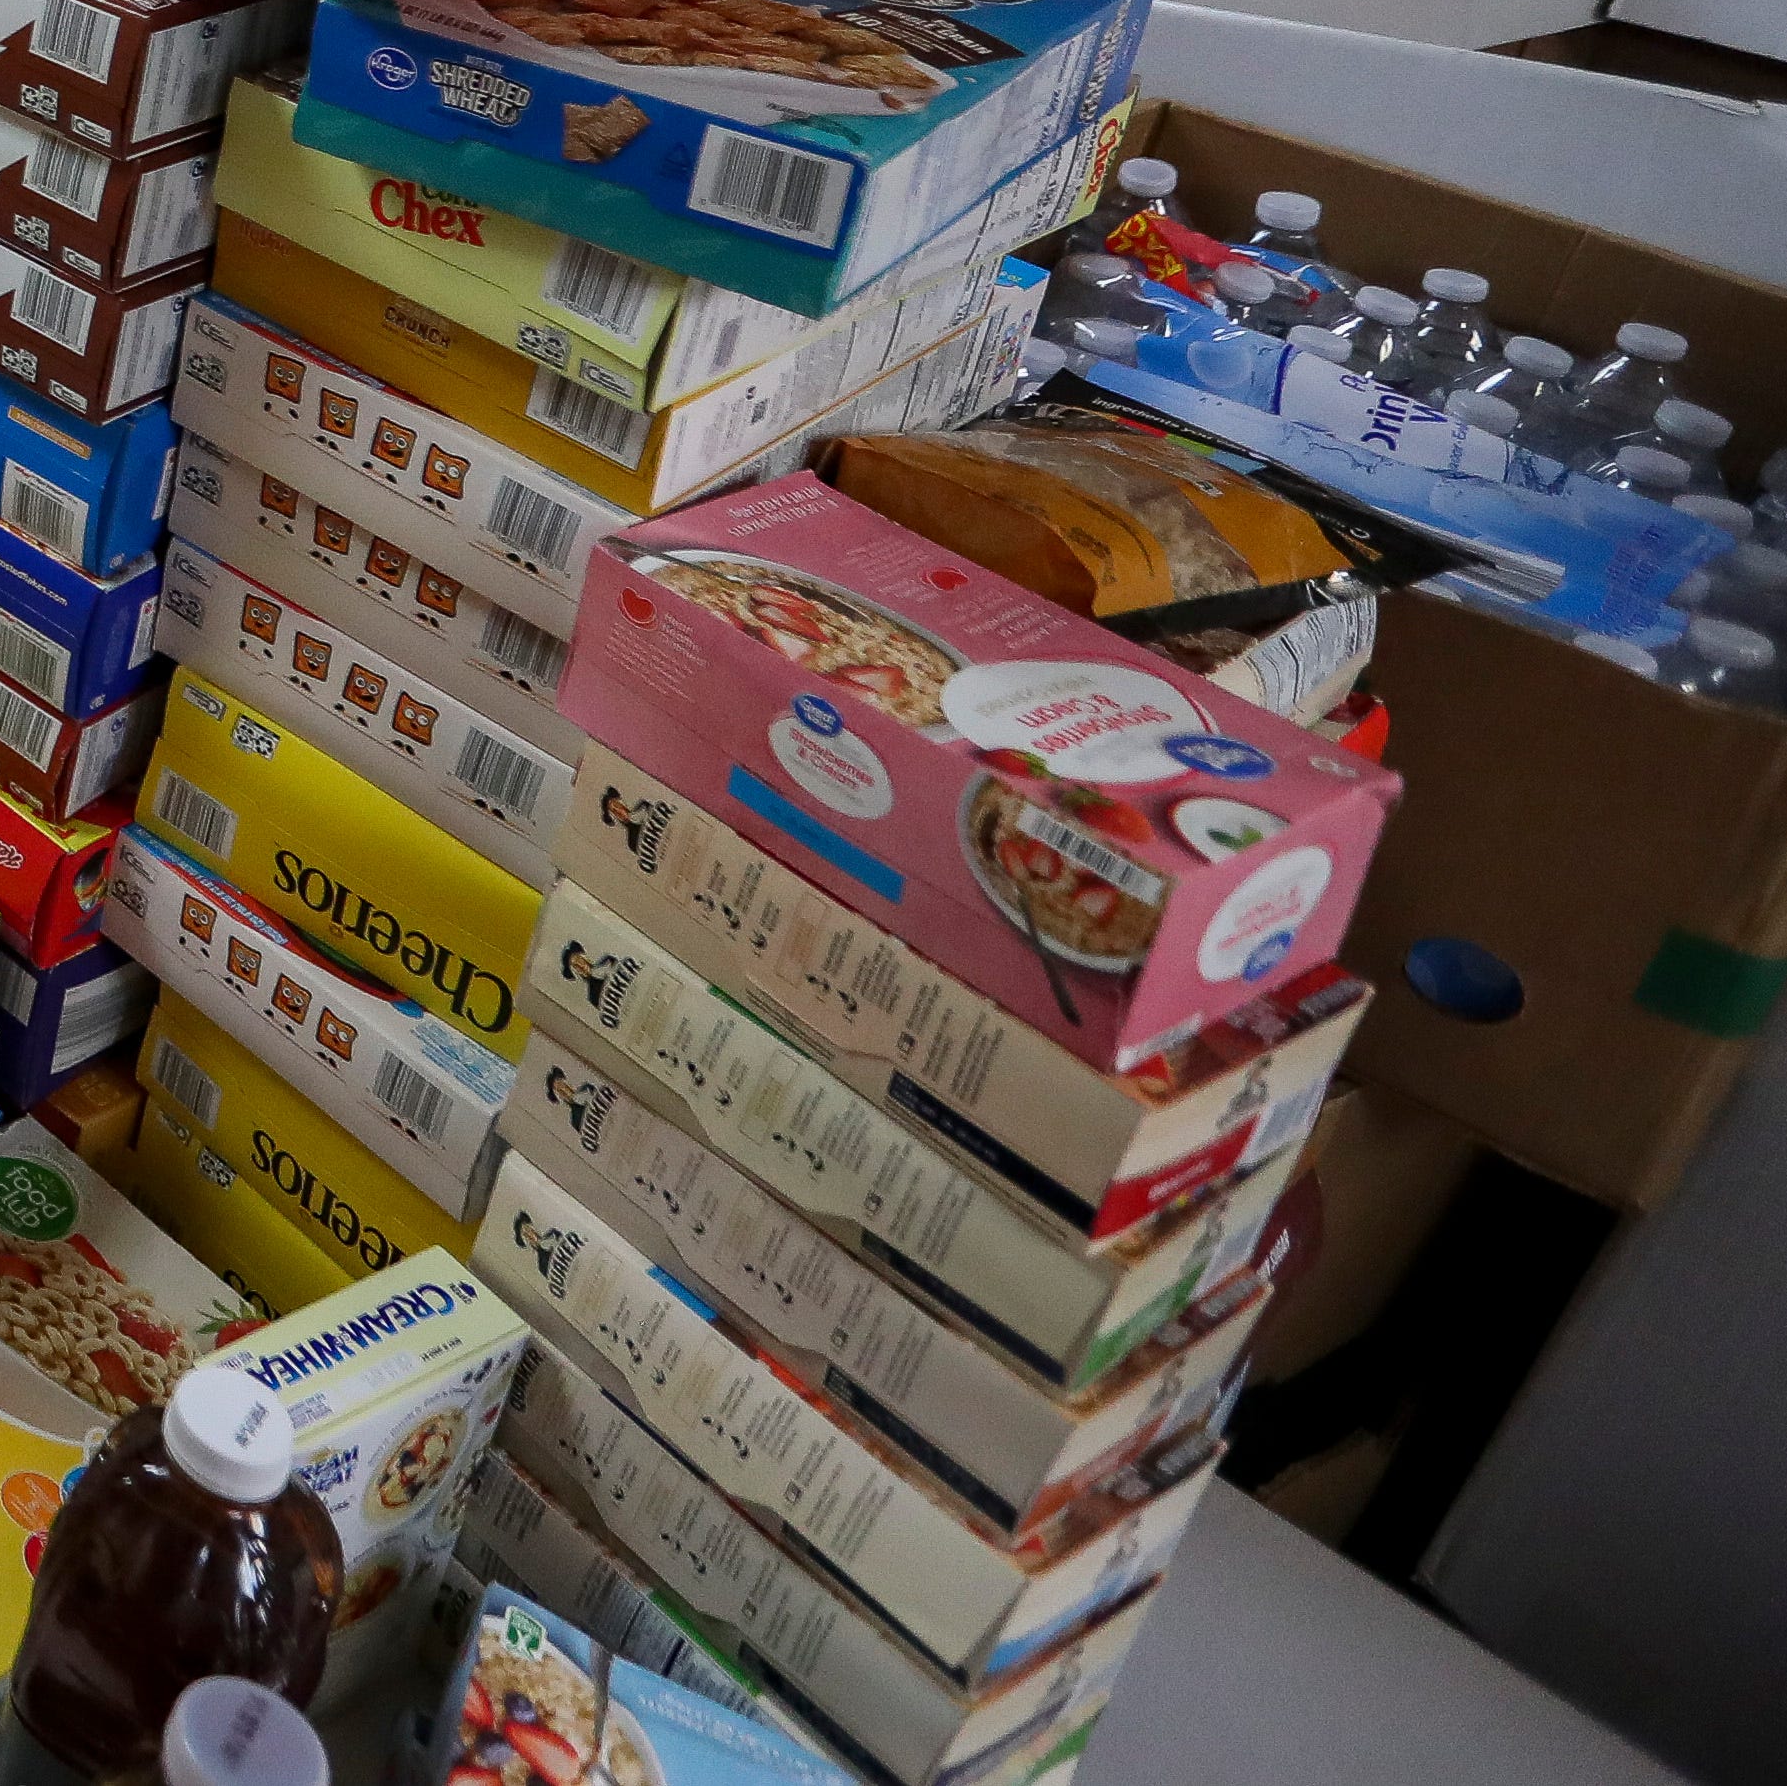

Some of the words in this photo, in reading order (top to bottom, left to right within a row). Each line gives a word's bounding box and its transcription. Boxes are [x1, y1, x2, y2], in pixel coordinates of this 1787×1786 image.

[371, 52, 417, 82] Kroger
[430, 59, 531, 110] SHREDDED
[443, 86, 518, 126] WHEAT
[370, 178, 485, 248] Chex
[637, 799, 678, 875] QUAKER
[274, 848, 514, 1034] Cheerios
[599, 957, 641, 1031] QUAKER
[580, 1084, 619, 1153] QUAKER
[5, 1165, 67, 1220] food
[548, 1233, 589, 1302] QUAKER
[339, 1283, 455, 1351] CREAM
